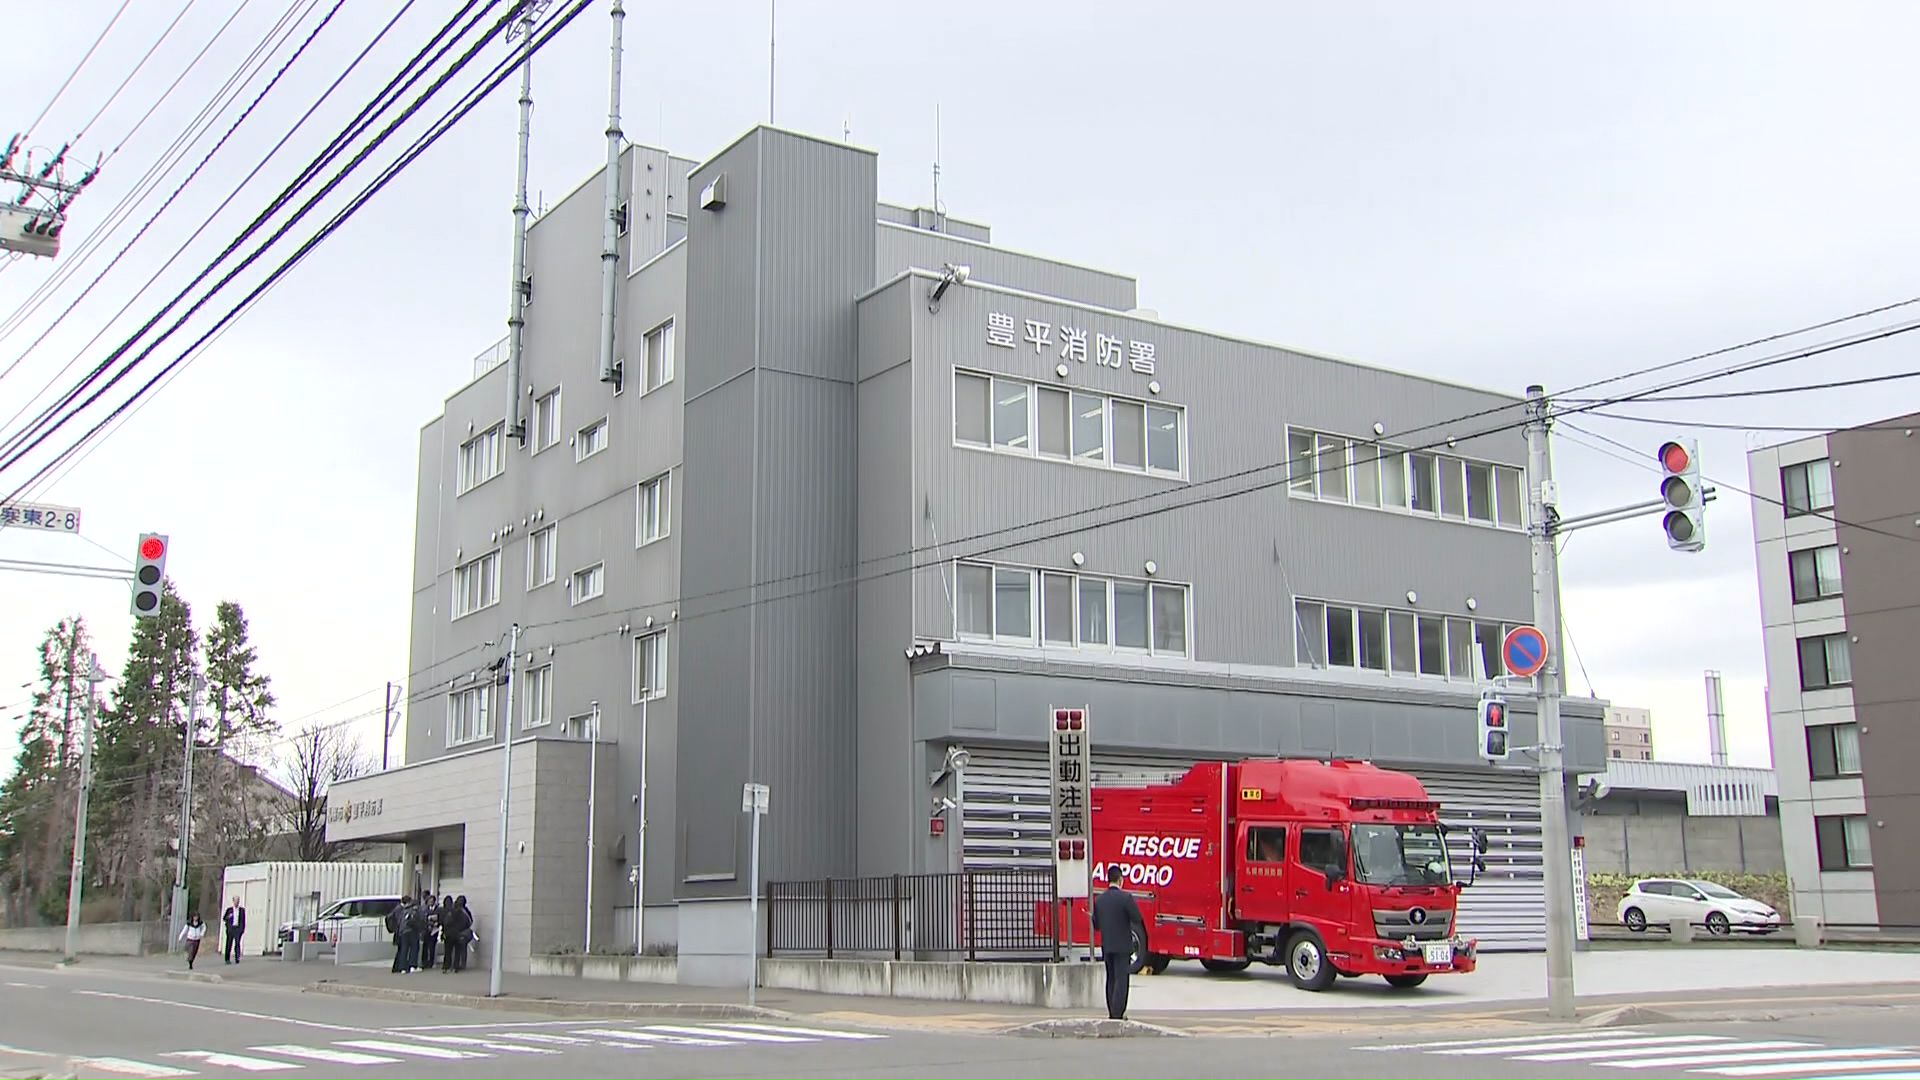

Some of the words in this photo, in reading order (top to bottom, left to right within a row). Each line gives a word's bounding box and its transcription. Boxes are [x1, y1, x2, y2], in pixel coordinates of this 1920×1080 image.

[986, 311, 1156, 375] 豊平消防署
[1058, 733, 1084, 836] 出動注意
[1121, 835, 1201, 859] RESCUE
[1092, 861, 1174, 887] APORO
